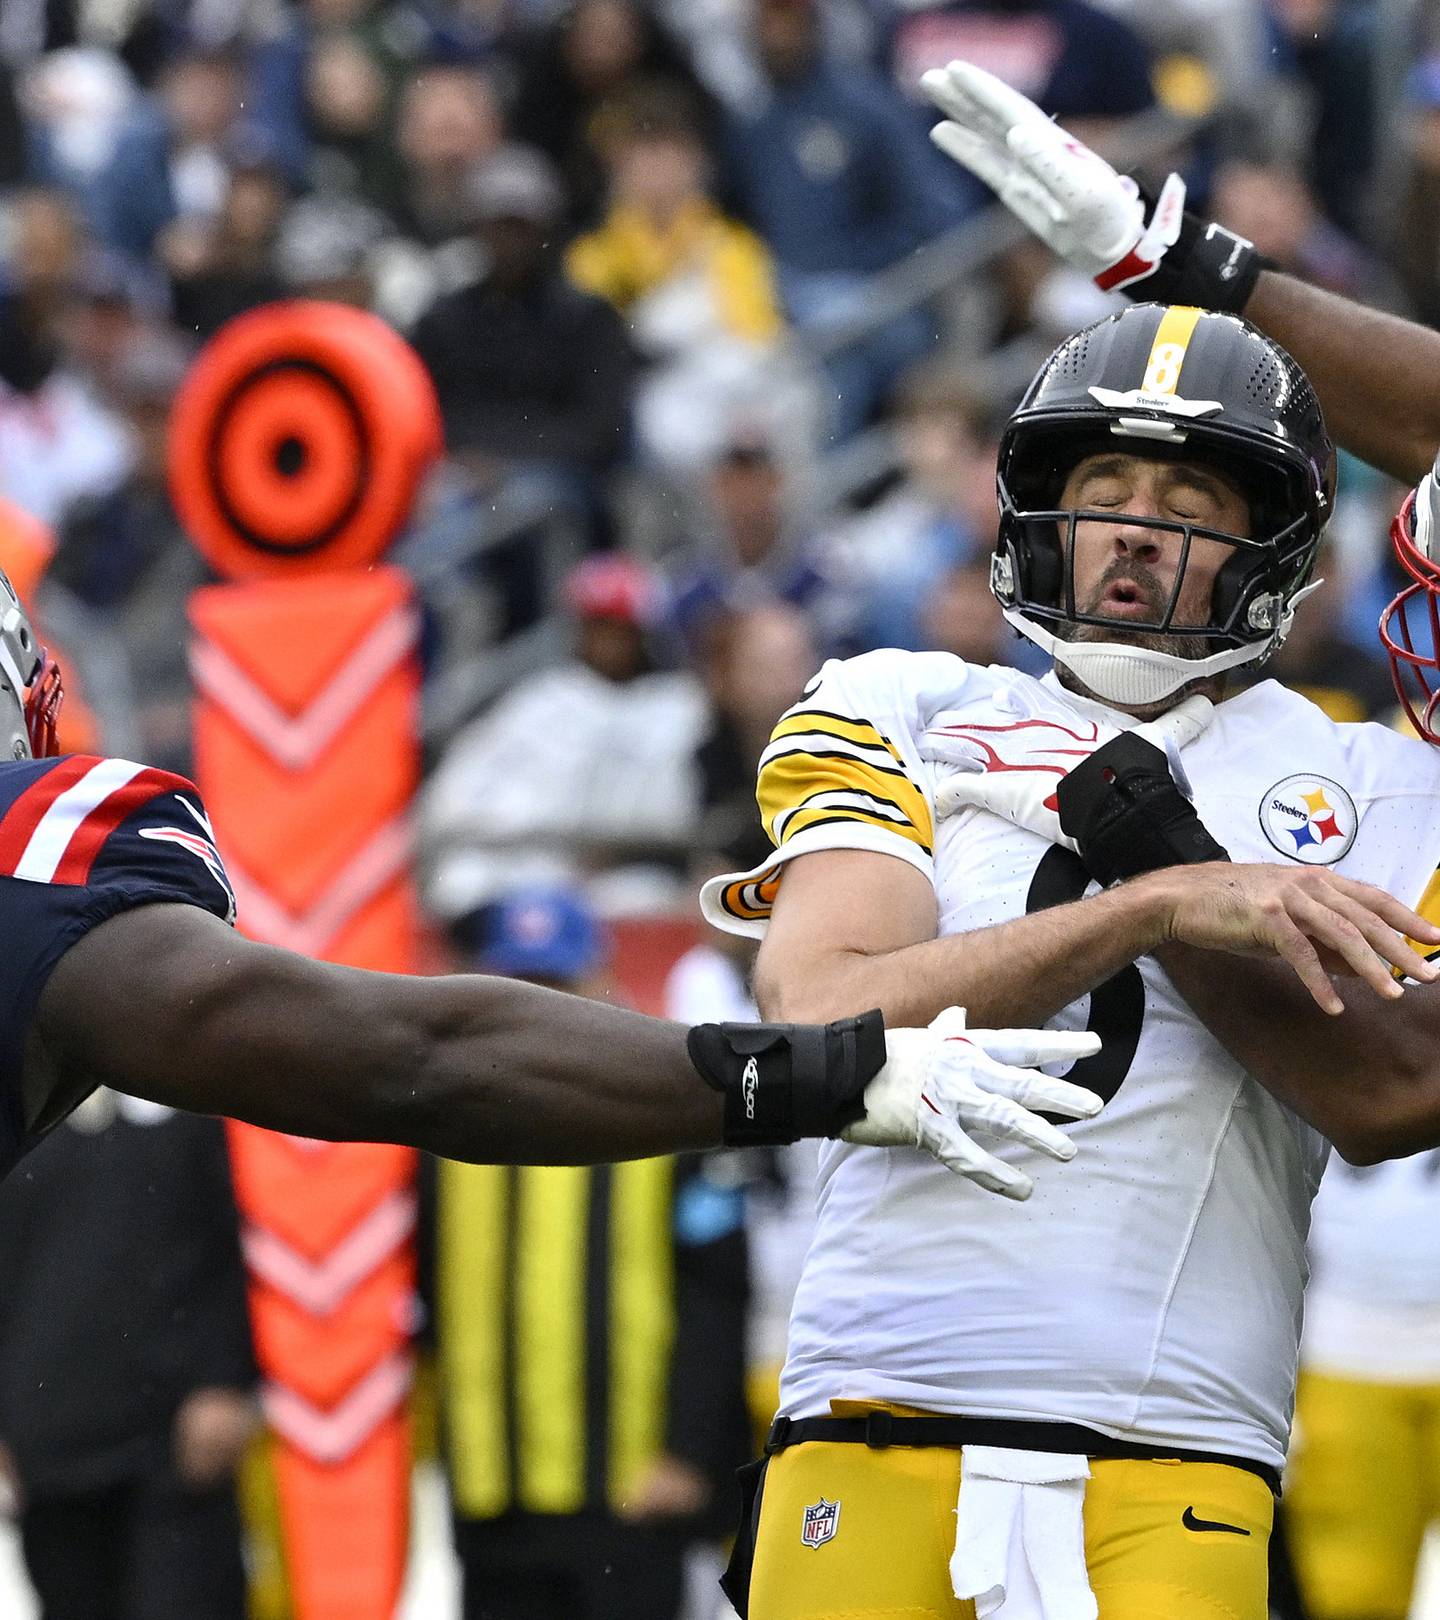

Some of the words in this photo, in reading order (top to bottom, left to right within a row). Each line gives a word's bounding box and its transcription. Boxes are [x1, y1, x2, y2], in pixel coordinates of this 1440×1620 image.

[1144, 342, 1186, 394] 8
[1271, 799, 1309, 822] Steelers
[806, 1519, 831, 1540] NFL
